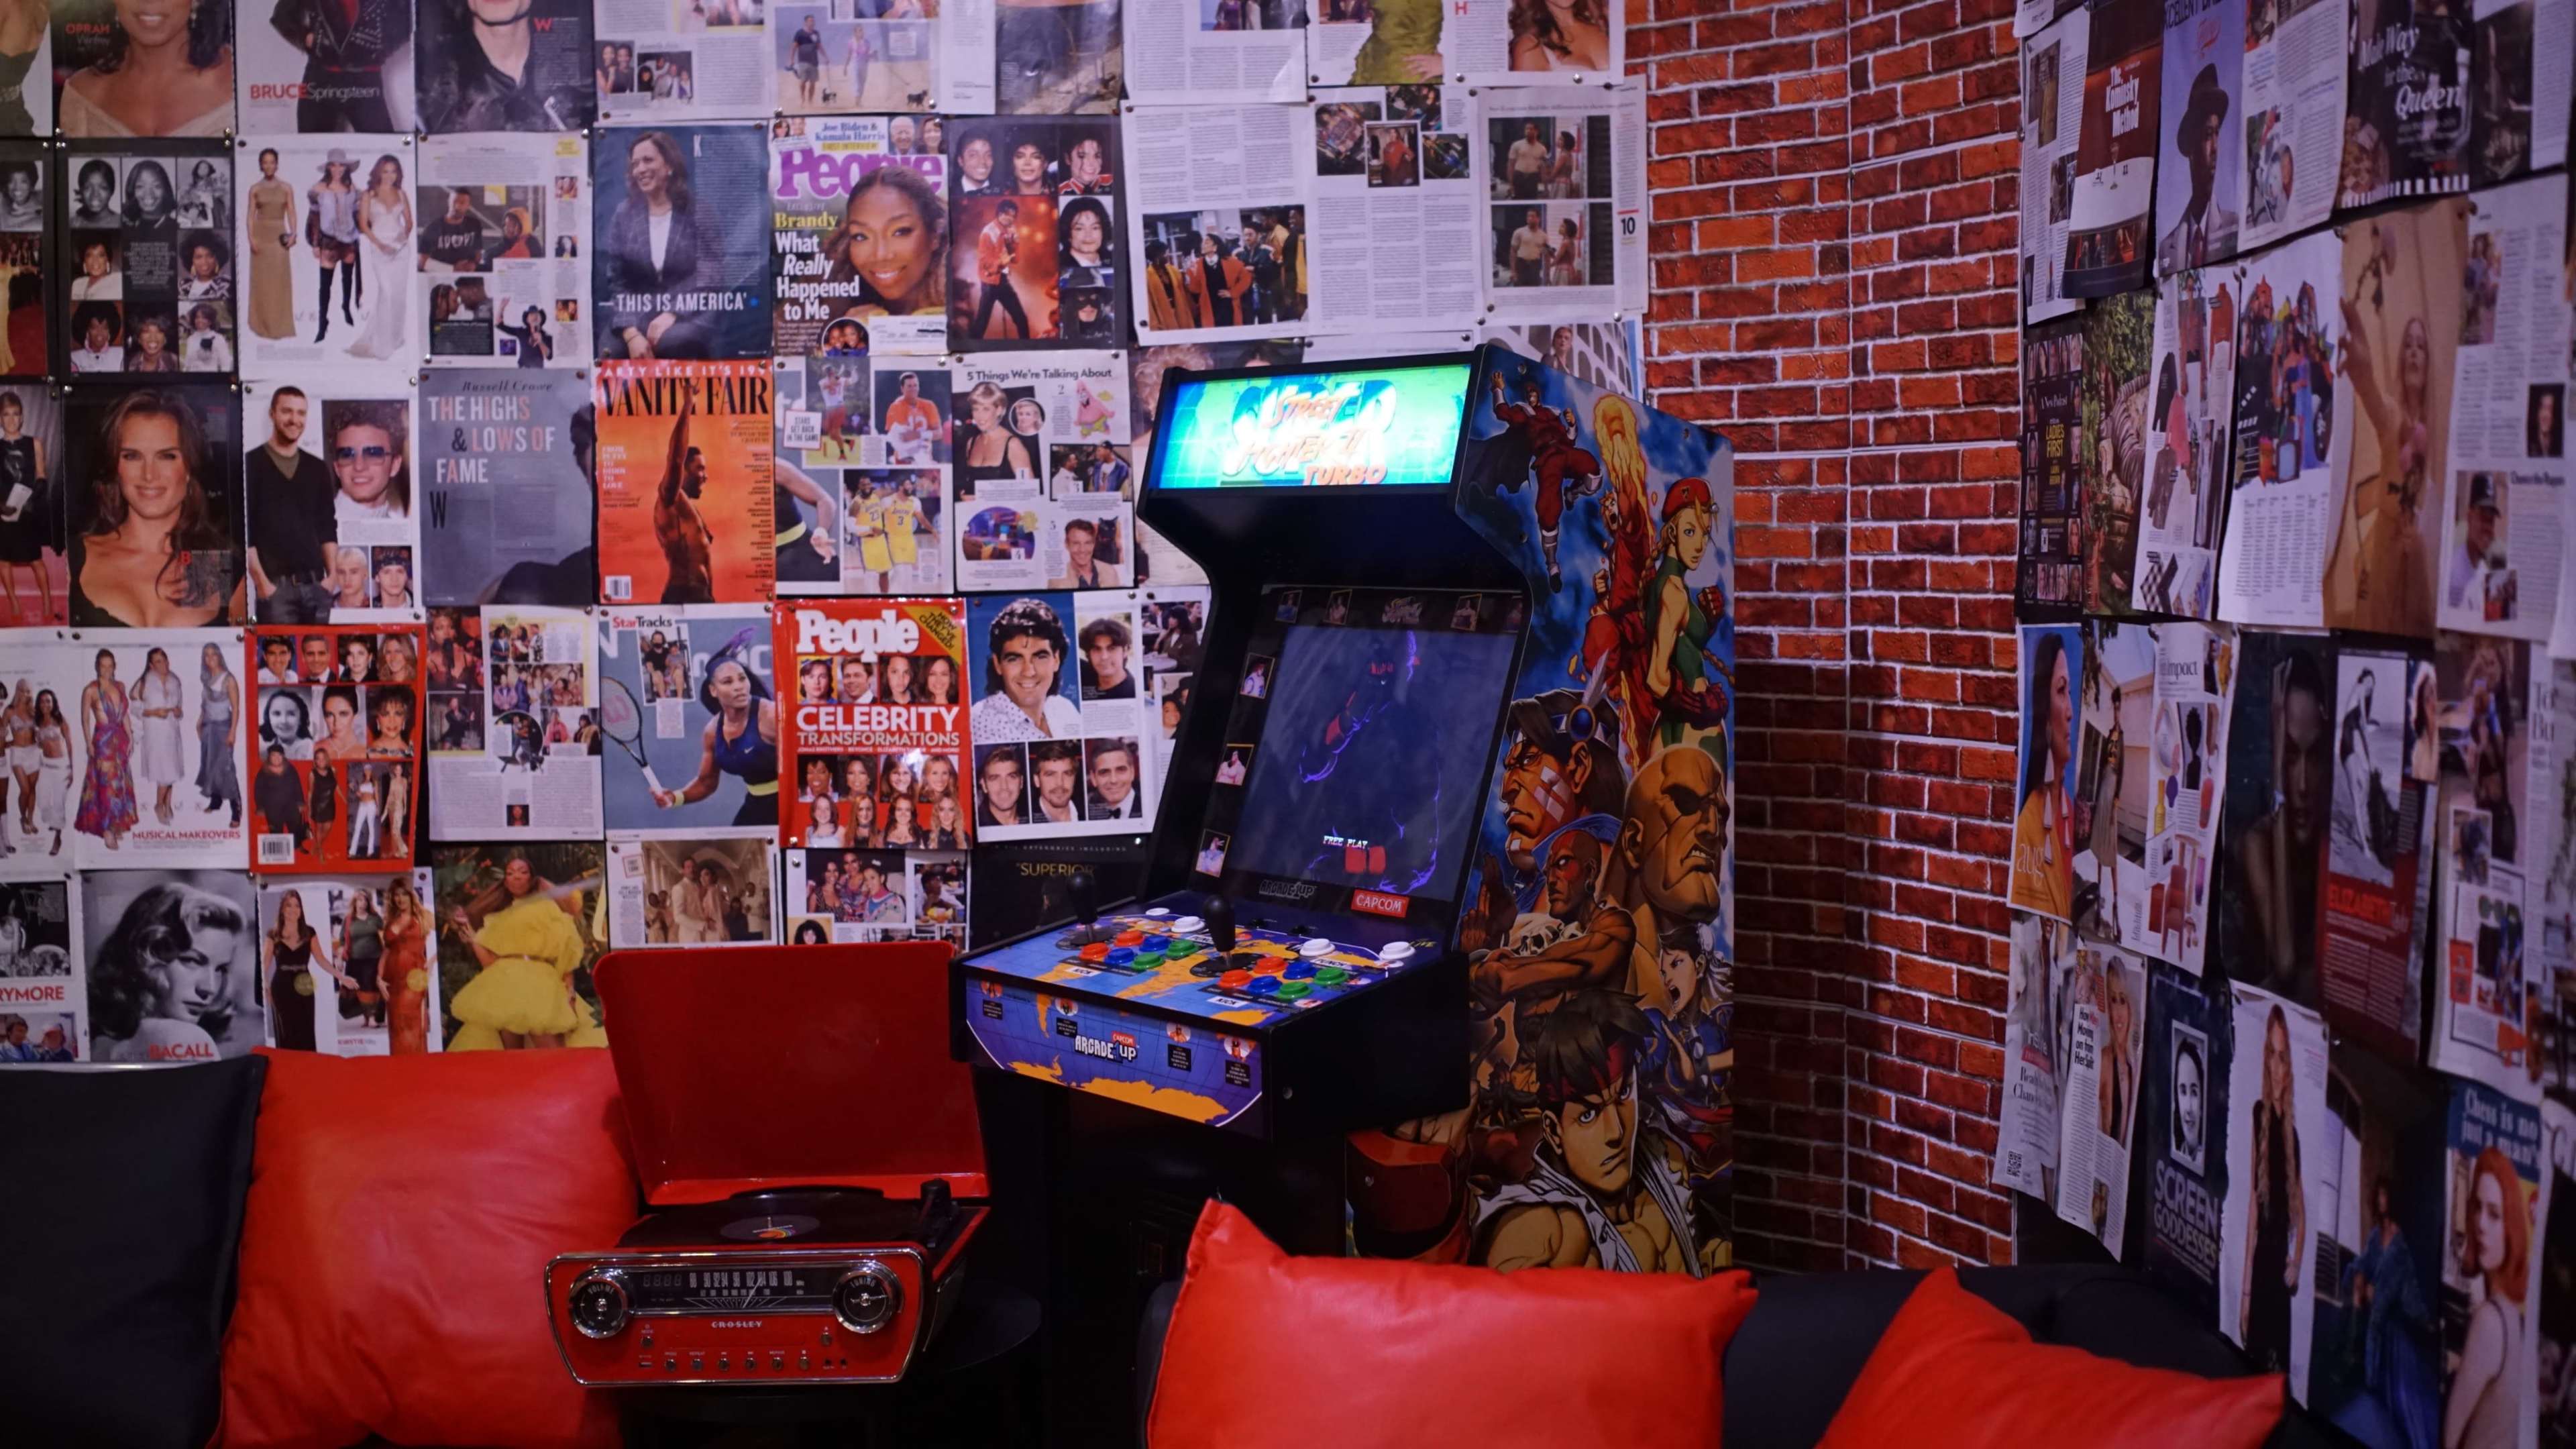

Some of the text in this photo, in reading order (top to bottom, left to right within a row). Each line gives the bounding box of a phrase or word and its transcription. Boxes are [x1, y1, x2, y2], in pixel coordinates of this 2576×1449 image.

[65, 23, 110, 34] OPRAH
[534, 17, 553, 31] W
[250, 82, 380, 102] BRUCE Springsteen
[2106, 75, 2140, 113] Kominsky
[2396, 84, 2463, 121] Queen
[822, 122, 837, 132] Joe
[841, 121, 868, 131] Biden
[2112, 101, 2140, 138] Method
[694, 134, 703, 158] K
[815, 131, 886, 142] Kamala Harris
[777, 149, 943, 198] Peoe
[774, 211, 839, 230] Brandy
[1620, 217, 1636, 235] 10
[775, 231, 820, 254] What
[782, 253, 835, 280] Really
[776, 274, 861, 304] Happened
[617, 292, 747, 313] THIS IS AMERICA'
[784, 299, 830, 321] to Me
[655, 365, 694, 376] LIKE
[702, 366, 732, 376] IT'S
[967, 368, 1112, 382] 5 Things We're Talking About
[462, 381, 553, 392] Russell Crowe
[603, 376, 769, 416] VANITY FAIR
[1057, 383, 1065, 395] 2
[428, 395, 531, 422] THE HIGHS
[452, 427, 555, 453] & LOWS OF
[2045, 423, 2065, 441] LADIES
[2047, 439, 2064, 458] FIRST
[437, 458, 488, 483] FAME
[1302, 466, 1387, 486] TURBO
[429, 491, 447, 529] W
[897, 515, 904, 527] 3
[612, 615, 673, 629] StarTracks
[795, 608, 920, 664] People
[796, 706, 959, 731] CELEBRITY
[796, 732, 960, 746] TRANSFORMATIONS
[132, 830, 241, 839] MUSICAL MAKEOVERS
[1322, 835, 1369, 849] FREE PLAY
[1356, 894, 1403, 912] CAPCOM
[1216, 996, 1238, 1005] KICK
[1075, 1035, 1137, 1063] ARCADE1UP
[1113, 1034, 1134, 1045] CAPCOM
[149, 1044, 214, 1059] BACALL
[2464, 1087, 2498, 1128] Chess
[2500, 1101, 2514, 1133] is
[2461, 1112, 2483, 1148] just
[2154, 1159, 2218, 1240] SCREEN
[2153, 1201, 2217, 1271] GODDESSES
[587, 1284, 615, 1295] VOLUME
[849, 1276, 876, 1288] TUNING
[710, 1320, 763, 1329] CROSLEY
